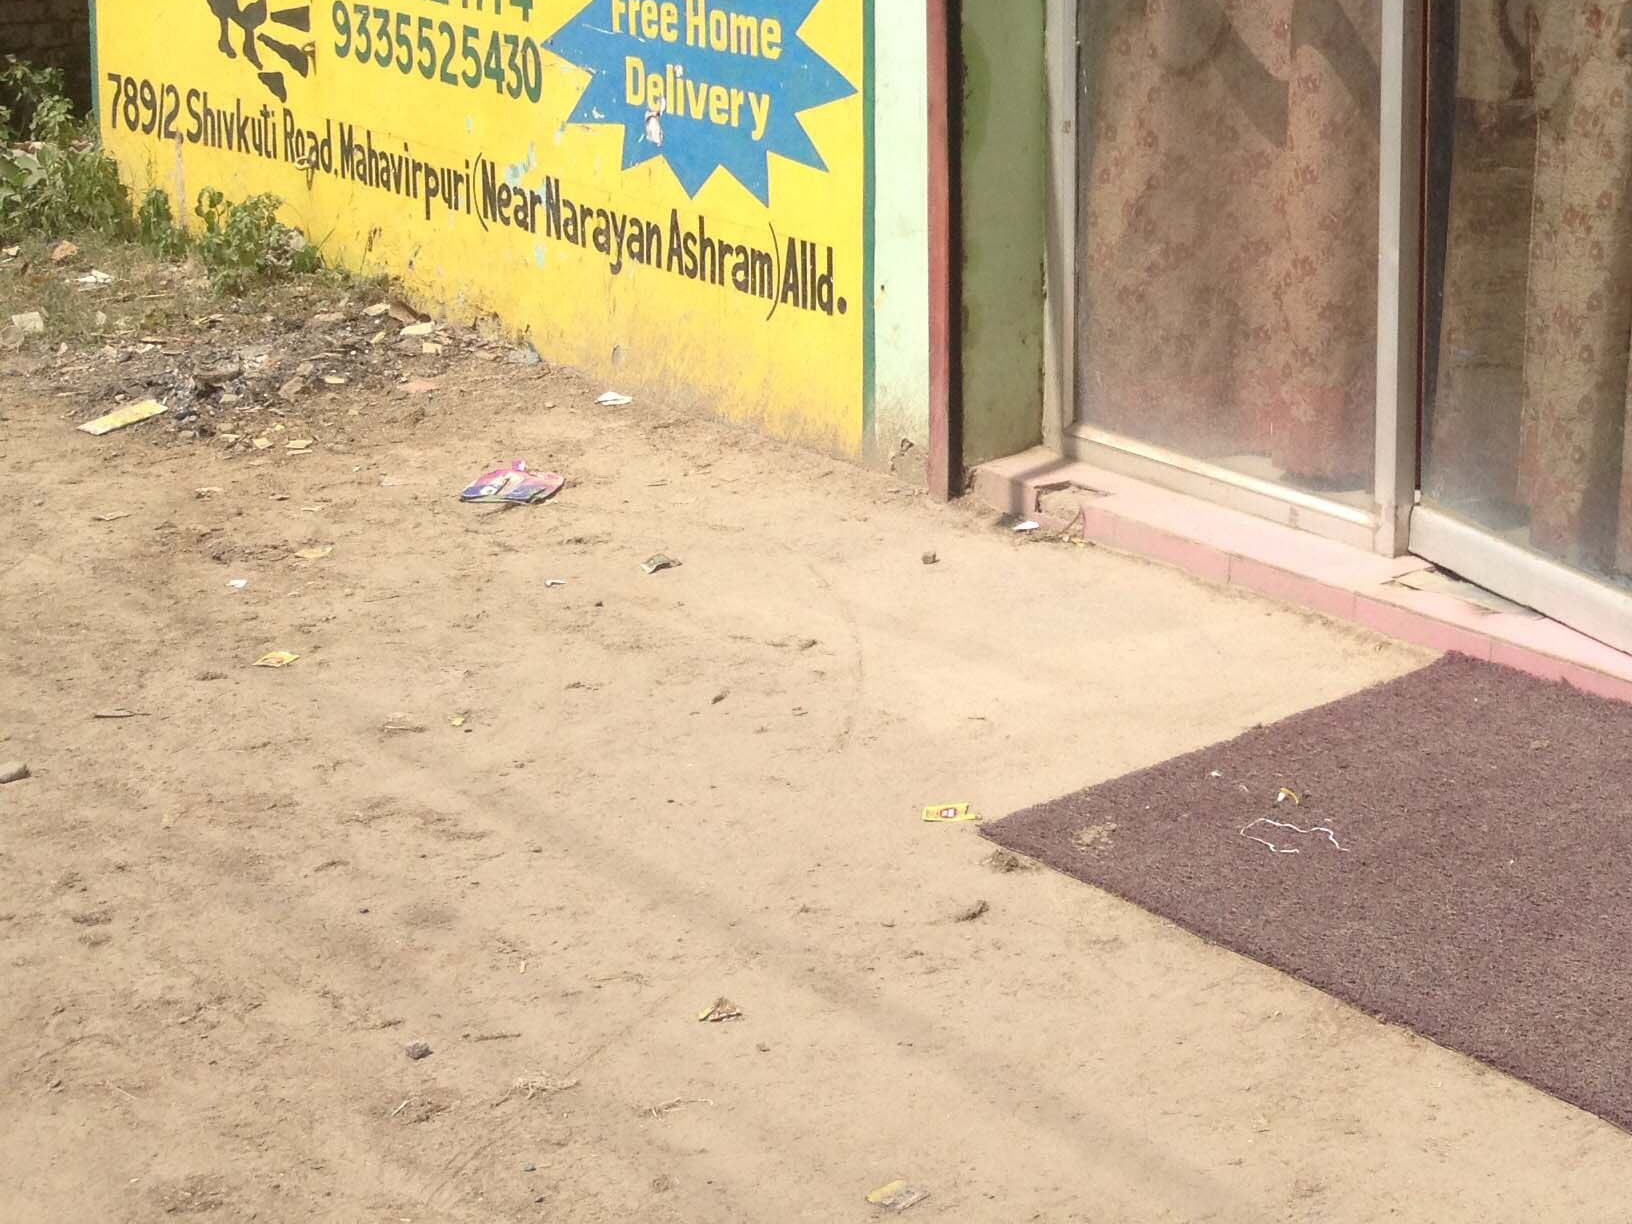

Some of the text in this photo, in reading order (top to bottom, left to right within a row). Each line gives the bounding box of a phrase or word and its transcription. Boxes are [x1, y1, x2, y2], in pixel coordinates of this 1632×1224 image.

[332, 0, 542, 103] 9335525430
[626, 55, 770, 141] Delivery
[186, 88, 277, 160] Shivkuti
[545, 176, 662, 275] Narayan
